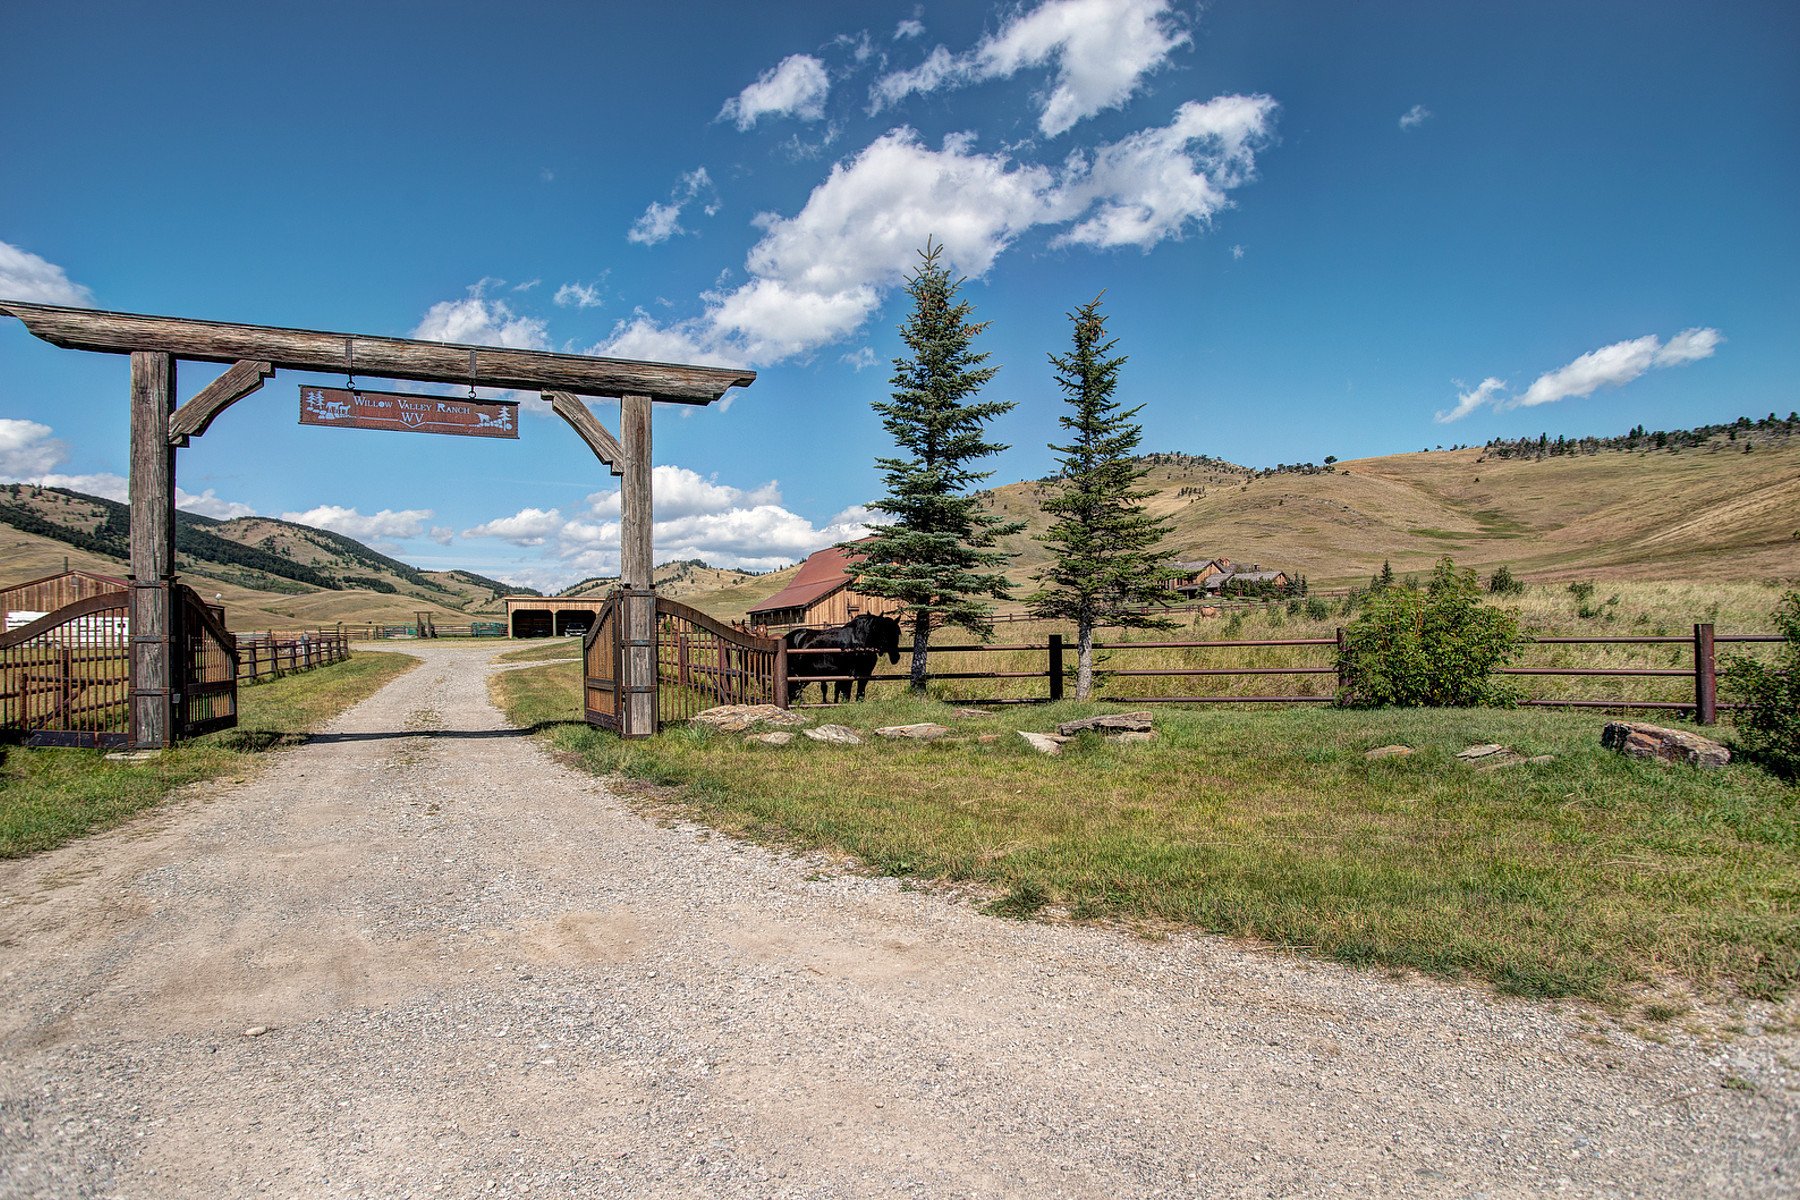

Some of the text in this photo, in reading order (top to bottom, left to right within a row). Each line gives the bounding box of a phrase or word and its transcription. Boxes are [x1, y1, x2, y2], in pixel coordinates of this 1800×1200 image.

[353, 395, 470, 415] WILLOW VALLEY RANCH
[401, 412, 424, 423] WV
